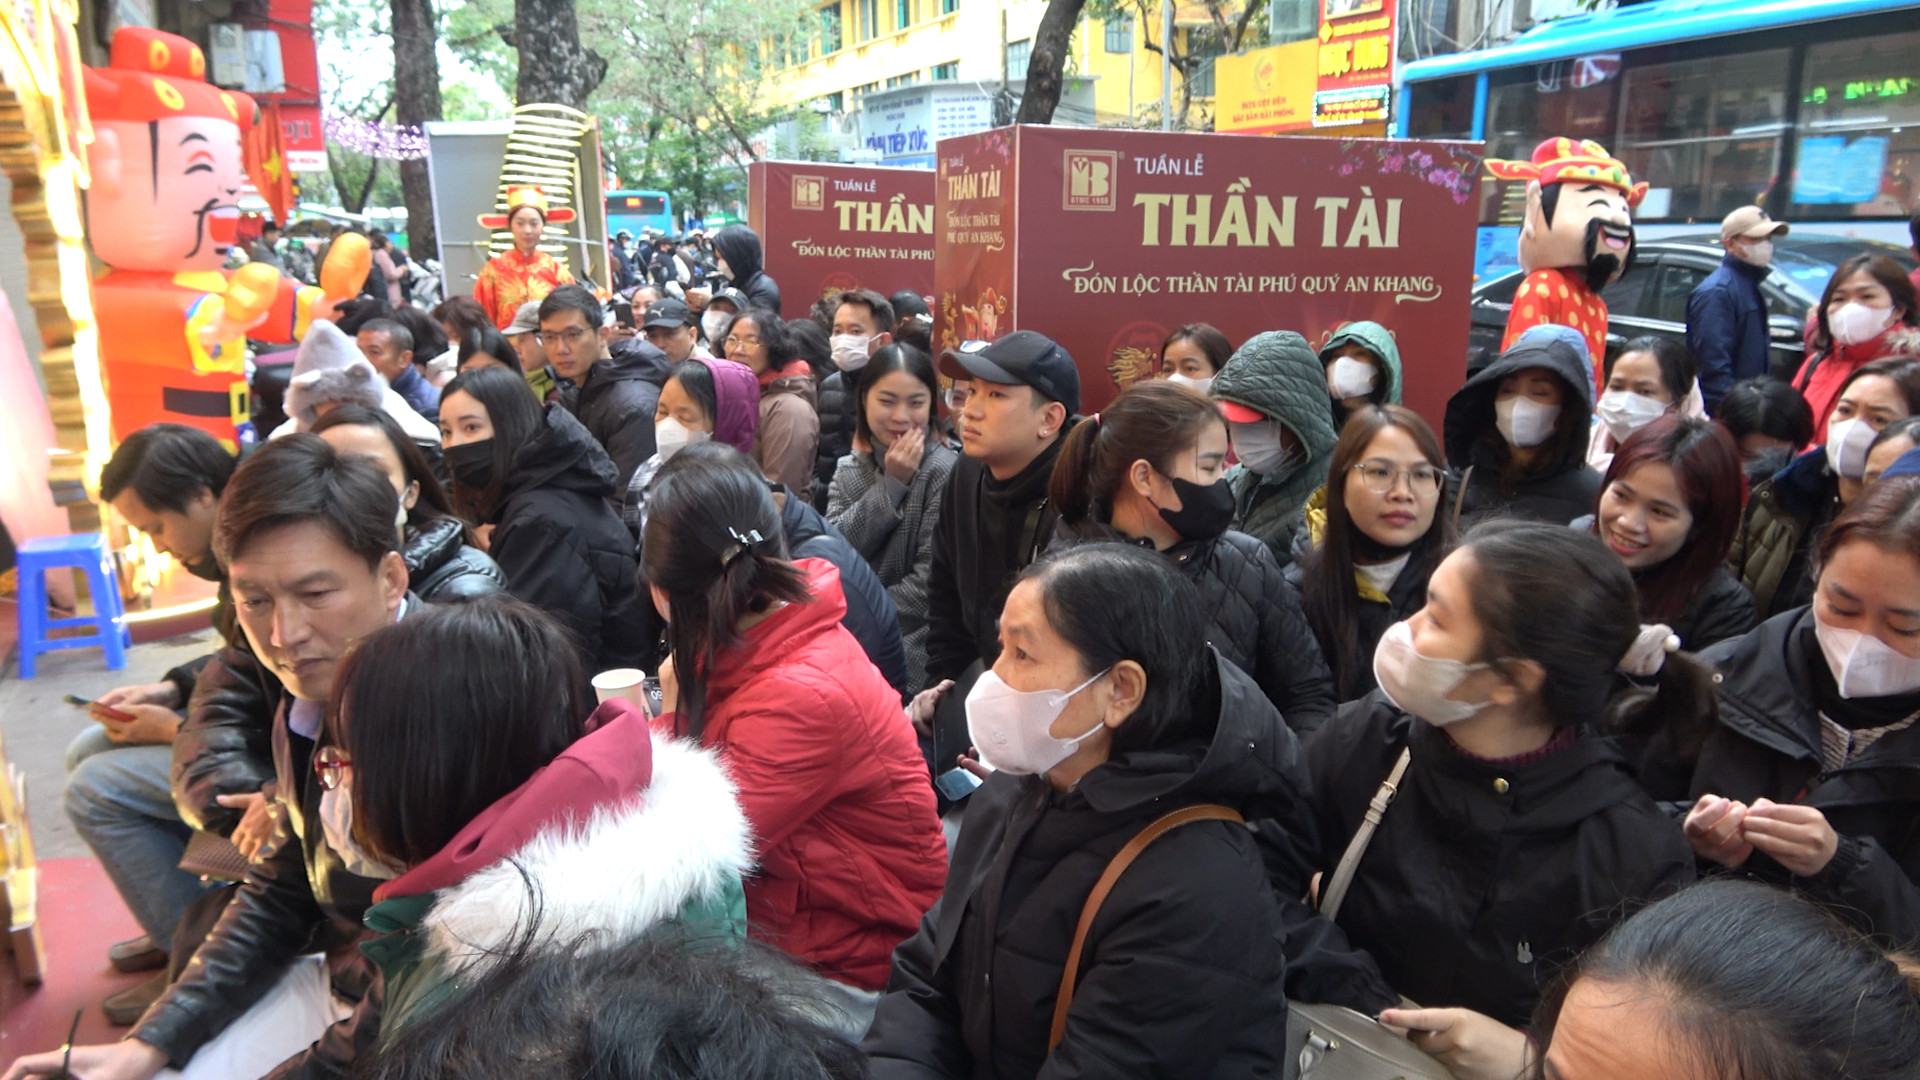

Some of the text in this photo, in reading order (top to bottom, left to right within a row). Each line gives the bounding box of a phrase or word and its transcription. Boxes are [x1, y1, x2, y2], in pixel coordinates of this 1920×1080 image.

[908, 124, 928, 152] XÚC
[1184, 153, 1204, 176] LỄ
[948, 165, 978, 201] THẦN
[981, 164, 1001, 198] TÀI
[833, 193, 935, 234] THẦN
[1133, 177, 1403, 248] THẦN TÀI
[799, 244, 935, 261] ĐÓN LỘC THẦN TÀI PHÚ
[1073, 271, 1434, 297] ĐÓN LỘC THẦN TÀI PHÚ QUÝ AN KHANG
